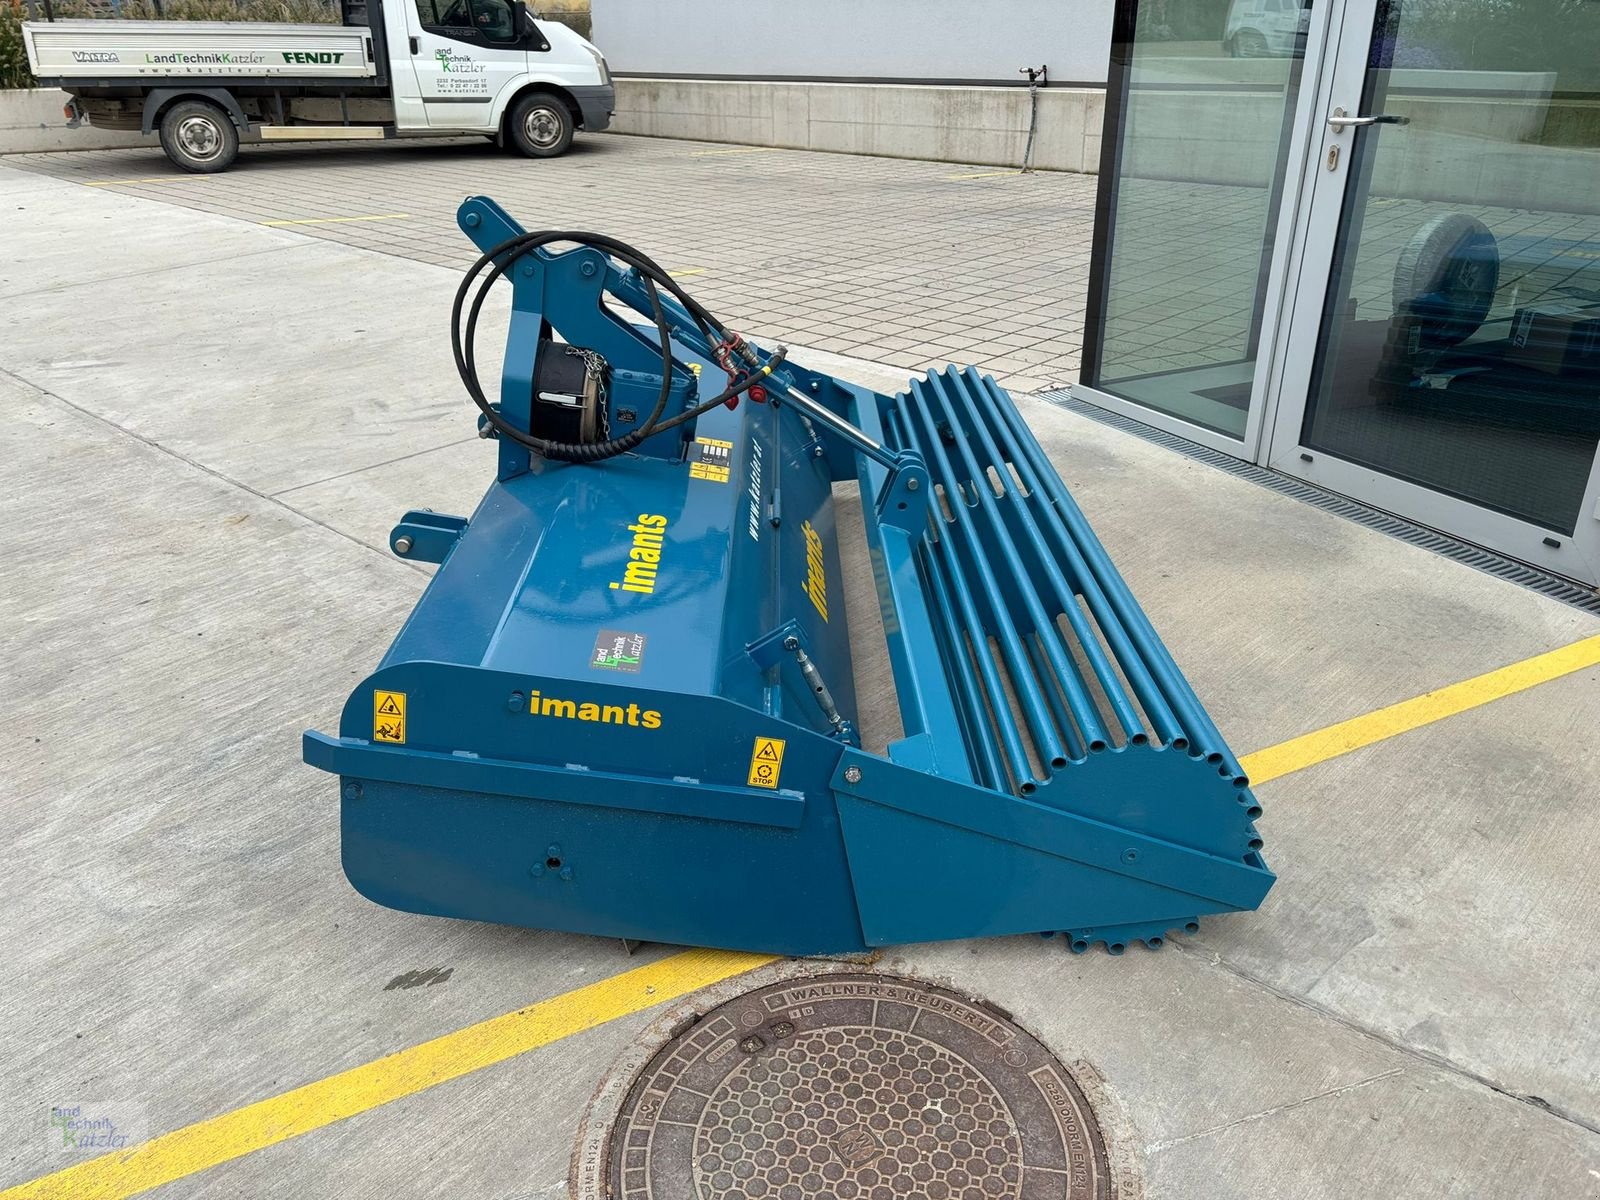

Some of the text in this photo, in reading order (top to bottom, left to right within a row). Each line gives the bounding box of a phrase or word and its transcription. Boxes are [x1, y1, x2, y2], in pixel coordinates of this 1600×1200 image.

[72, 51, 120, 63] VALTRA
[282, 52, 344, 64] FENDT
[441, 62, 486, 73] Katzler
[609, 513, 668, 594] imants
[530, 690, 662, 729] imants
[752, 777, 773, 785] STOP
[791, 984, 988, 1028] WALLNER & NEUBERT
[1073, 1153, 1087, 1190] EN124
